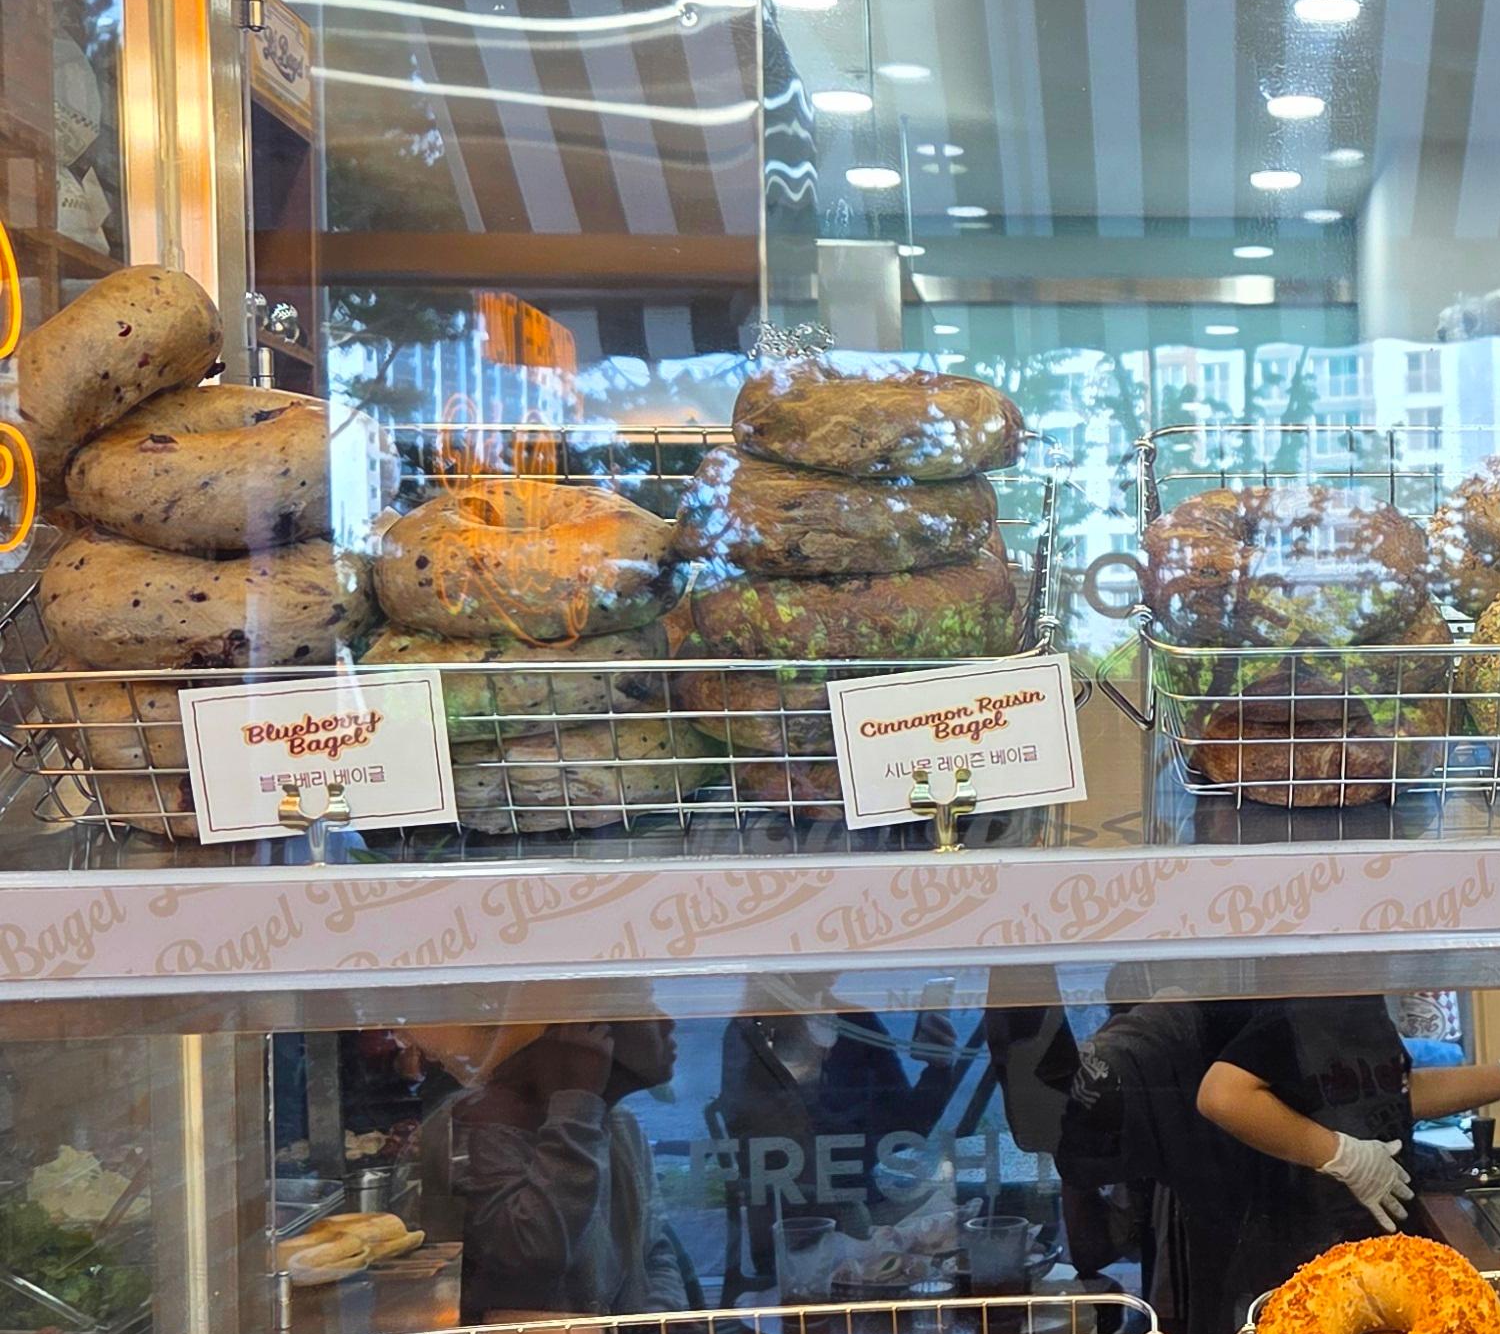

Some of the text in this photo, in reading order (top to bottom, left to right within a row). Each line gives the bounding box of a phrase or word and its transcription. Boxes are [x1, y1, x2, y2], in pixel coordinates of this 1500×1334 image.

[244, 709, 380, 744] Blueberry
[860, 688, 1046, 739] Cinnamon Raisin
[932, 711, 1008, 744] Bagel
[288, 728, 368, 760] Bagel
[884, 744, 1039, 779] 시나몬 레이즌 베이글
[259, 765, 386, 793] 블루베리 베이글
